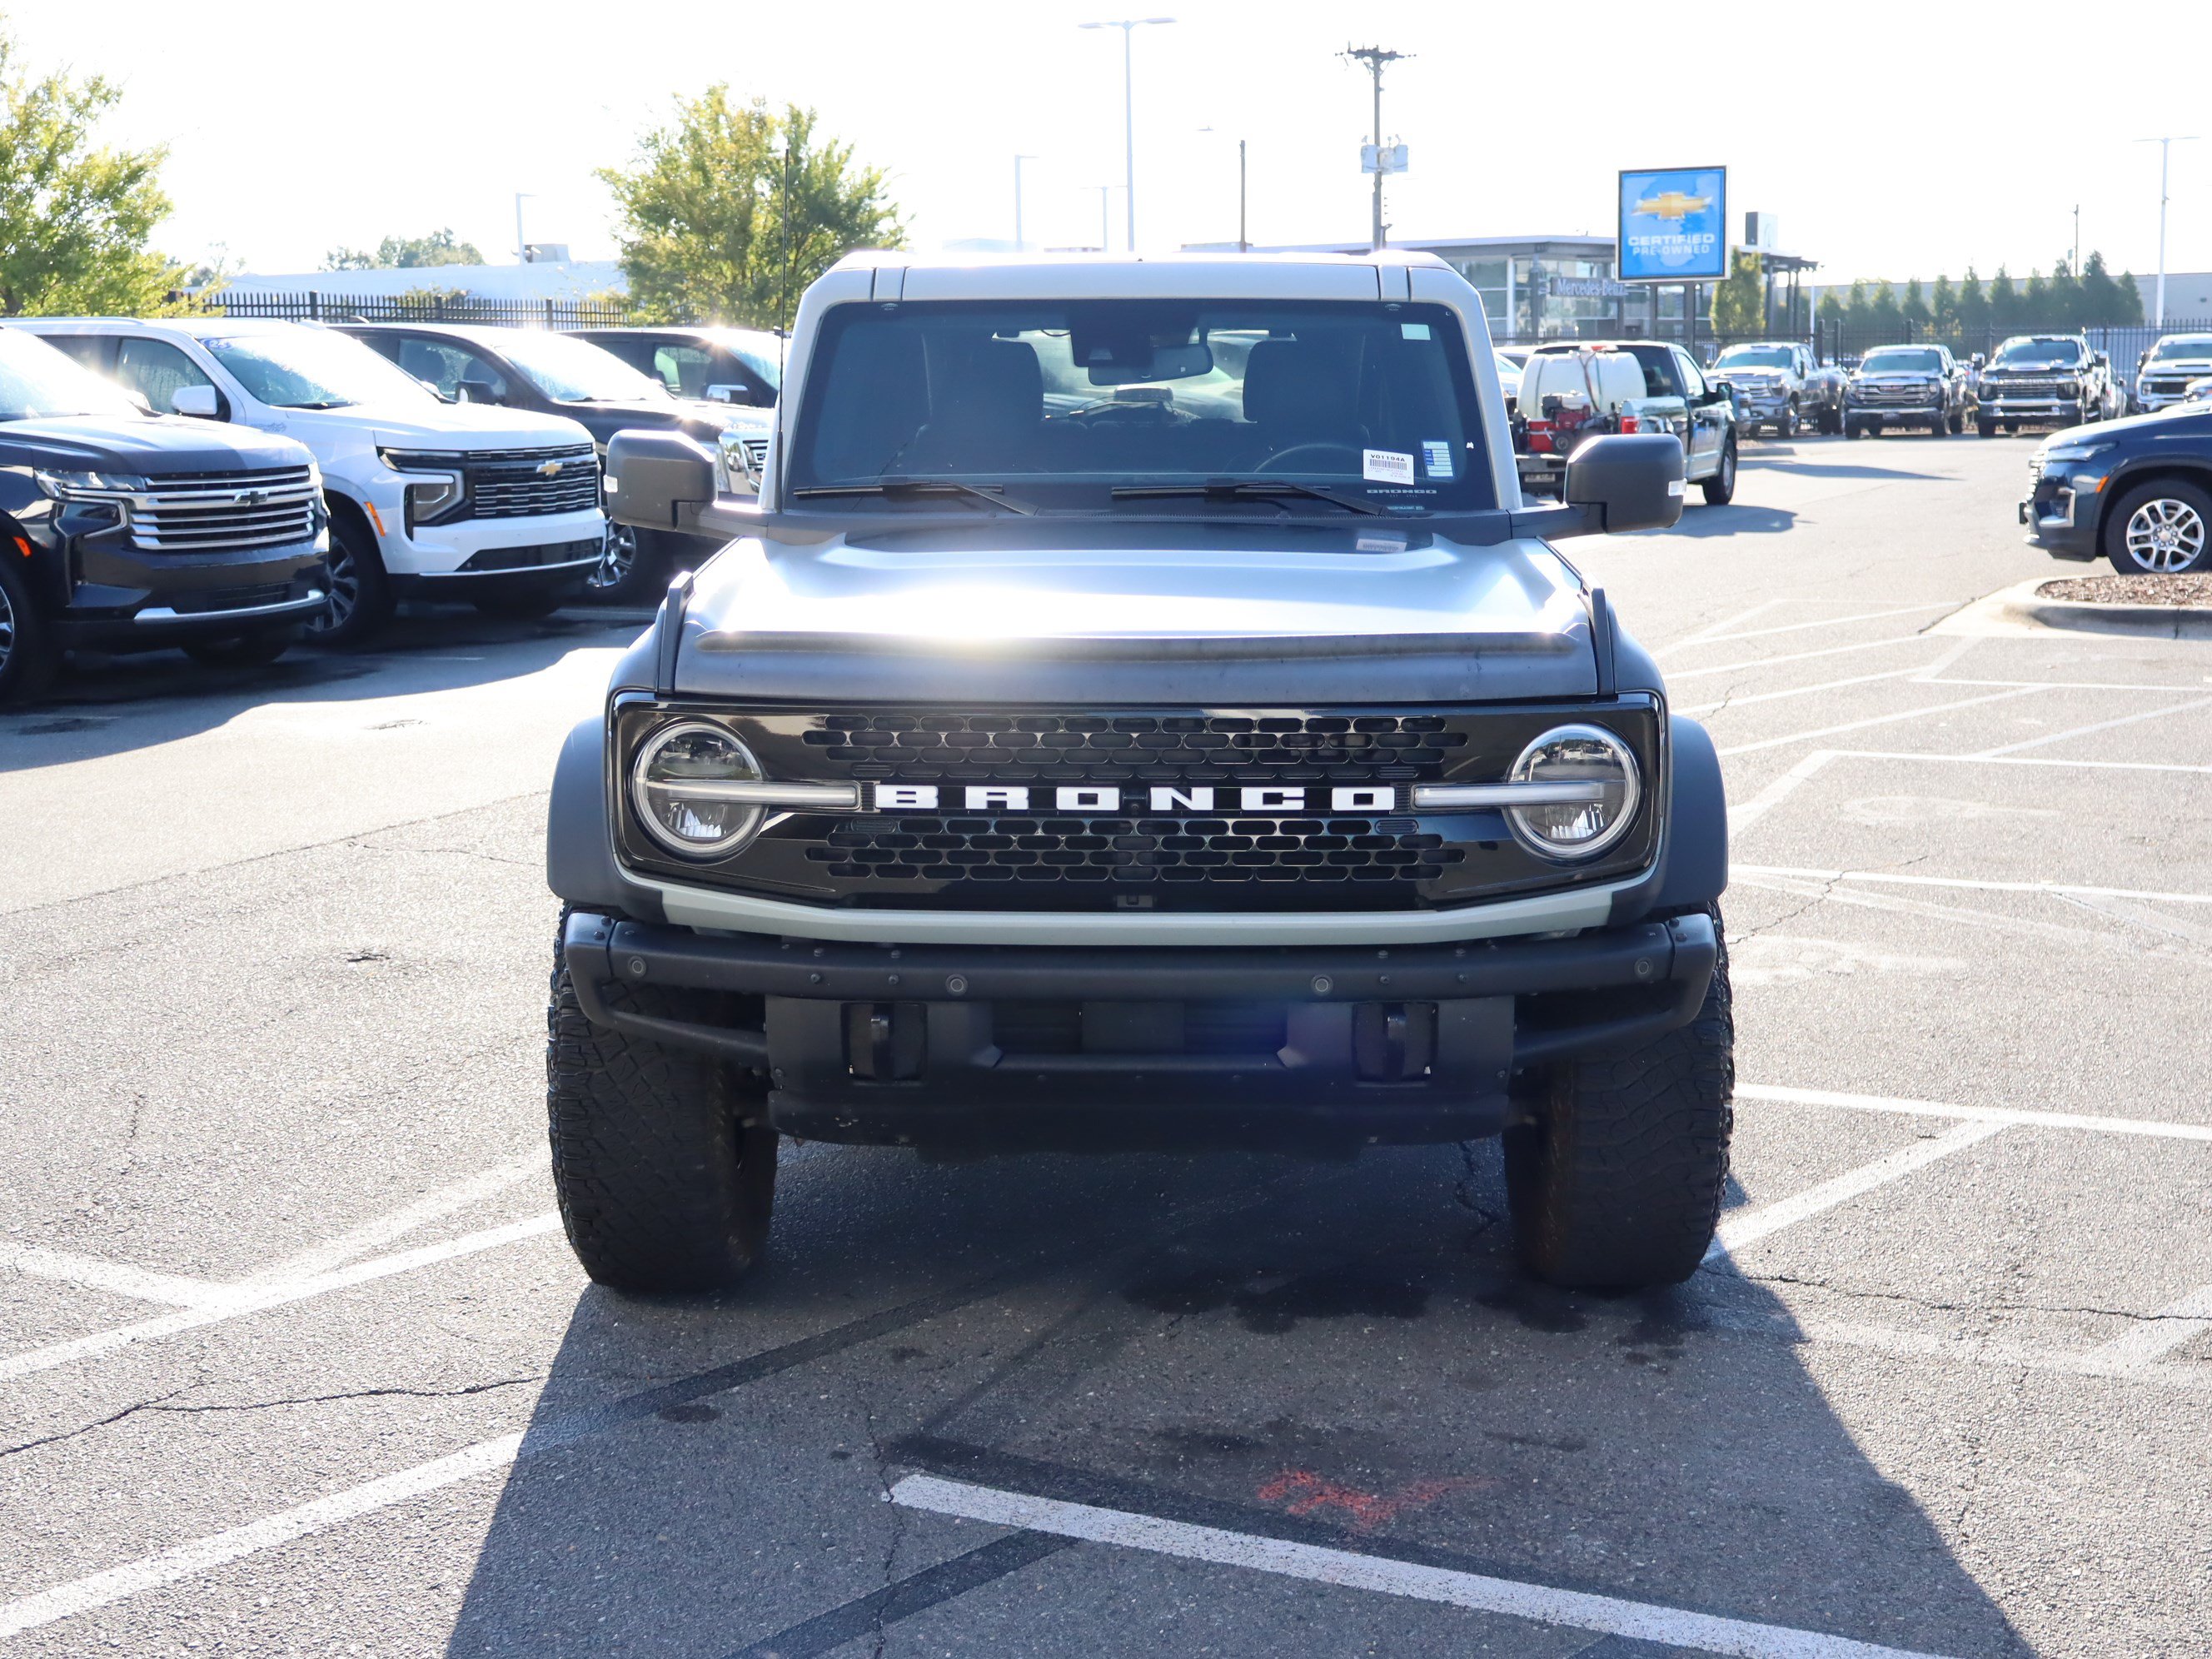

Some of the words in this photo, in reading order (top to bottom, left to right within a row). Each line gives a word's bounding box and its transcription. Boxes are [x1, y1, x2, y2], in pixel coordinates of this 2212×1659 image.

[1628, 234, 1715, 246] CERTIFIED
[1632, 245, 1709, 255] PRE-OWNED
[1557, 278, 1625, 296] Mercedes-Benz
[875, 785, 1395, 810] BRONCO
